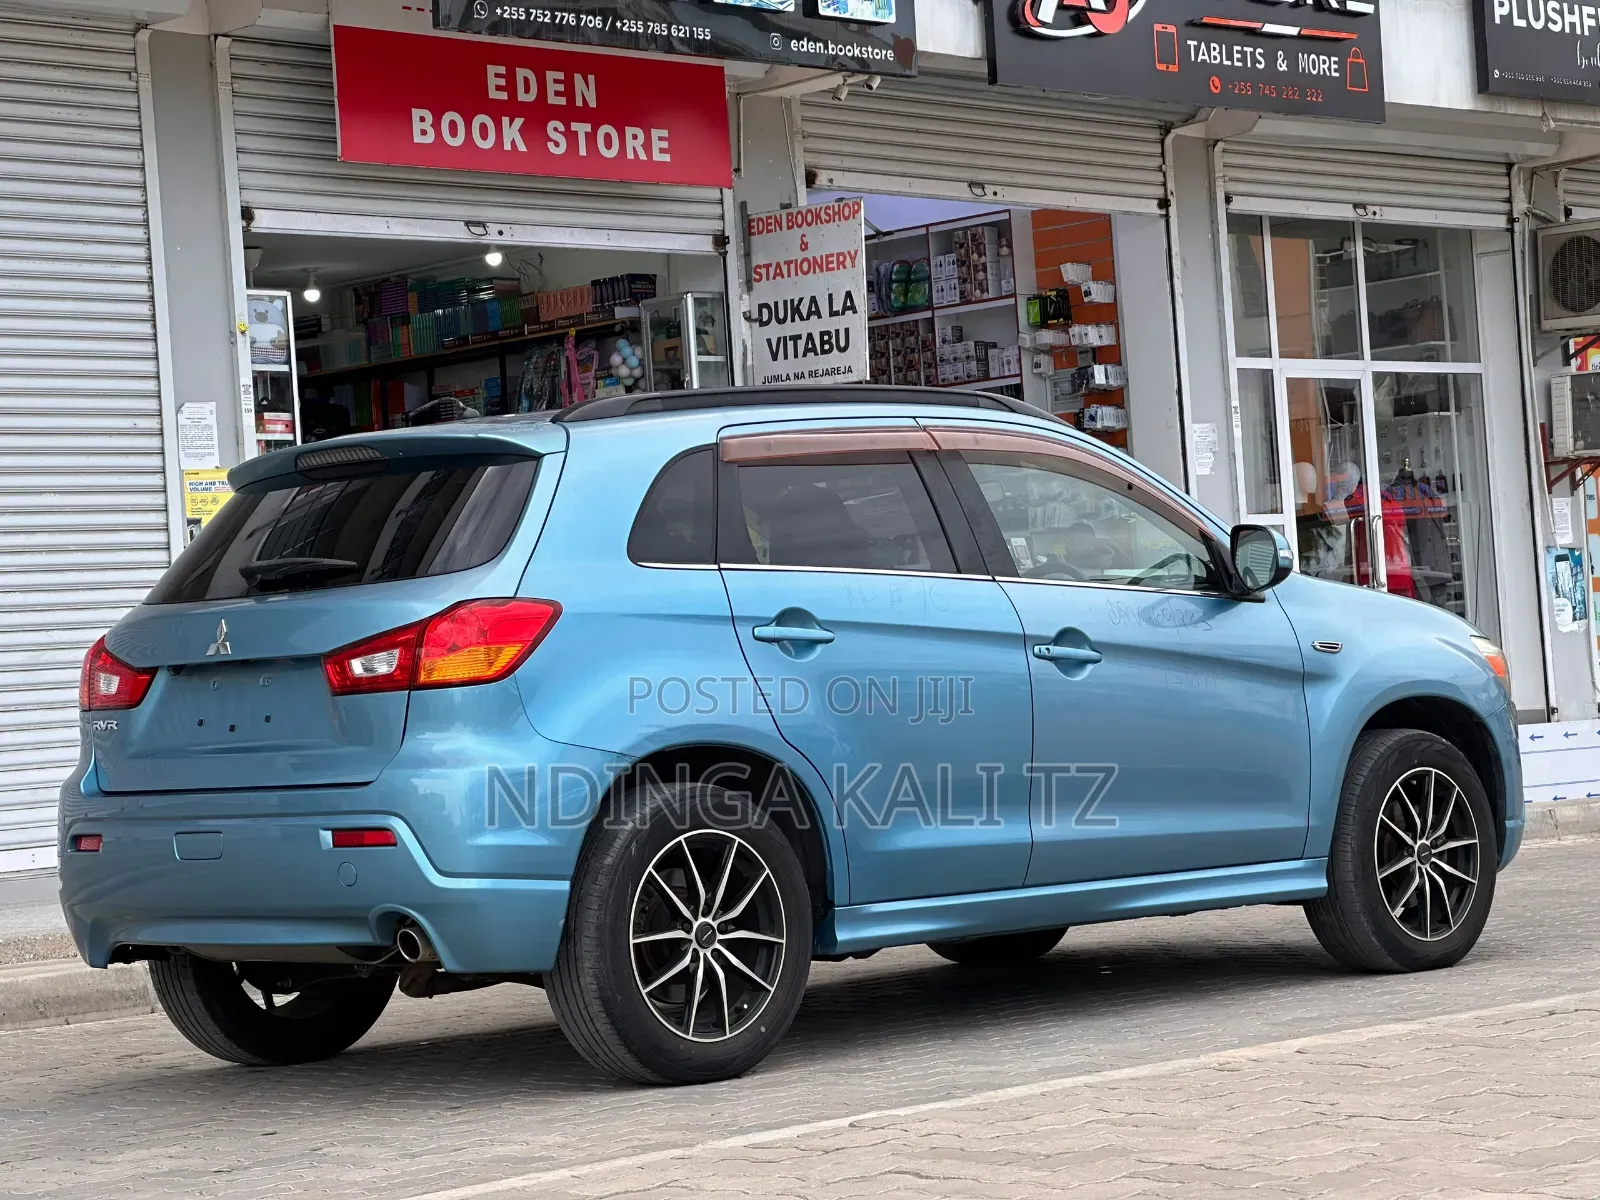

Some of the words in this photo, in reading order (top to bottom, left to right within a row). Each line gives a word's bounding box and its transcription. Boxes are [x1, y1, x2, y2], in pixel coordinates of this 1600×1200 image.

[495, 6, 526, 21] +255
[529, 9, 550, 24] 752
[553, 11, 576, 26] 776
[580, 13, 603, 28] 706
[605, 16, 612, 31] /
[616, 19, 645, 33] +255
[647, 22, 669, 36] 785
[671, 24, 690, 38] 621
[692, 26, 711, 40] 155
[1493, 0, 1600, 36] PLUSHF
[790, 37, 894, 62] eden.bookstore
[1187, 40, 1265, 69] TABLETS
[1277, 50, 1288, 72] &
[1299, 53, 1340, 77] MORE
[486, 64, 597, 108] EDEN
[1228, 81, 1252, 95] +255
[1259, 84, 1276, 97] 745
[1282, 87, 1299, 99] 282
[1306, 89, 1323, 101] 322
[411, 108, 527, 152] BOOK
[546, 120, 671, 162] STORE
[748, 213, 782, 237] EDEN
[786, 200, 860, 230] BOOKSHOP
[800, 233, 808, 252] &
[752, 249, 858, 283] STATIONERY
[757, 295, 822, 328] DUKA
[828, 290, 858, 318] LA
[766, 327, 850, 362] VITABU
[762, 372, 791, 385] JUMLA
[793, 371, 806, 381] NA
[808, 365, 853, 378] REJAREJA
[93, 720, 118, 730] RVR
